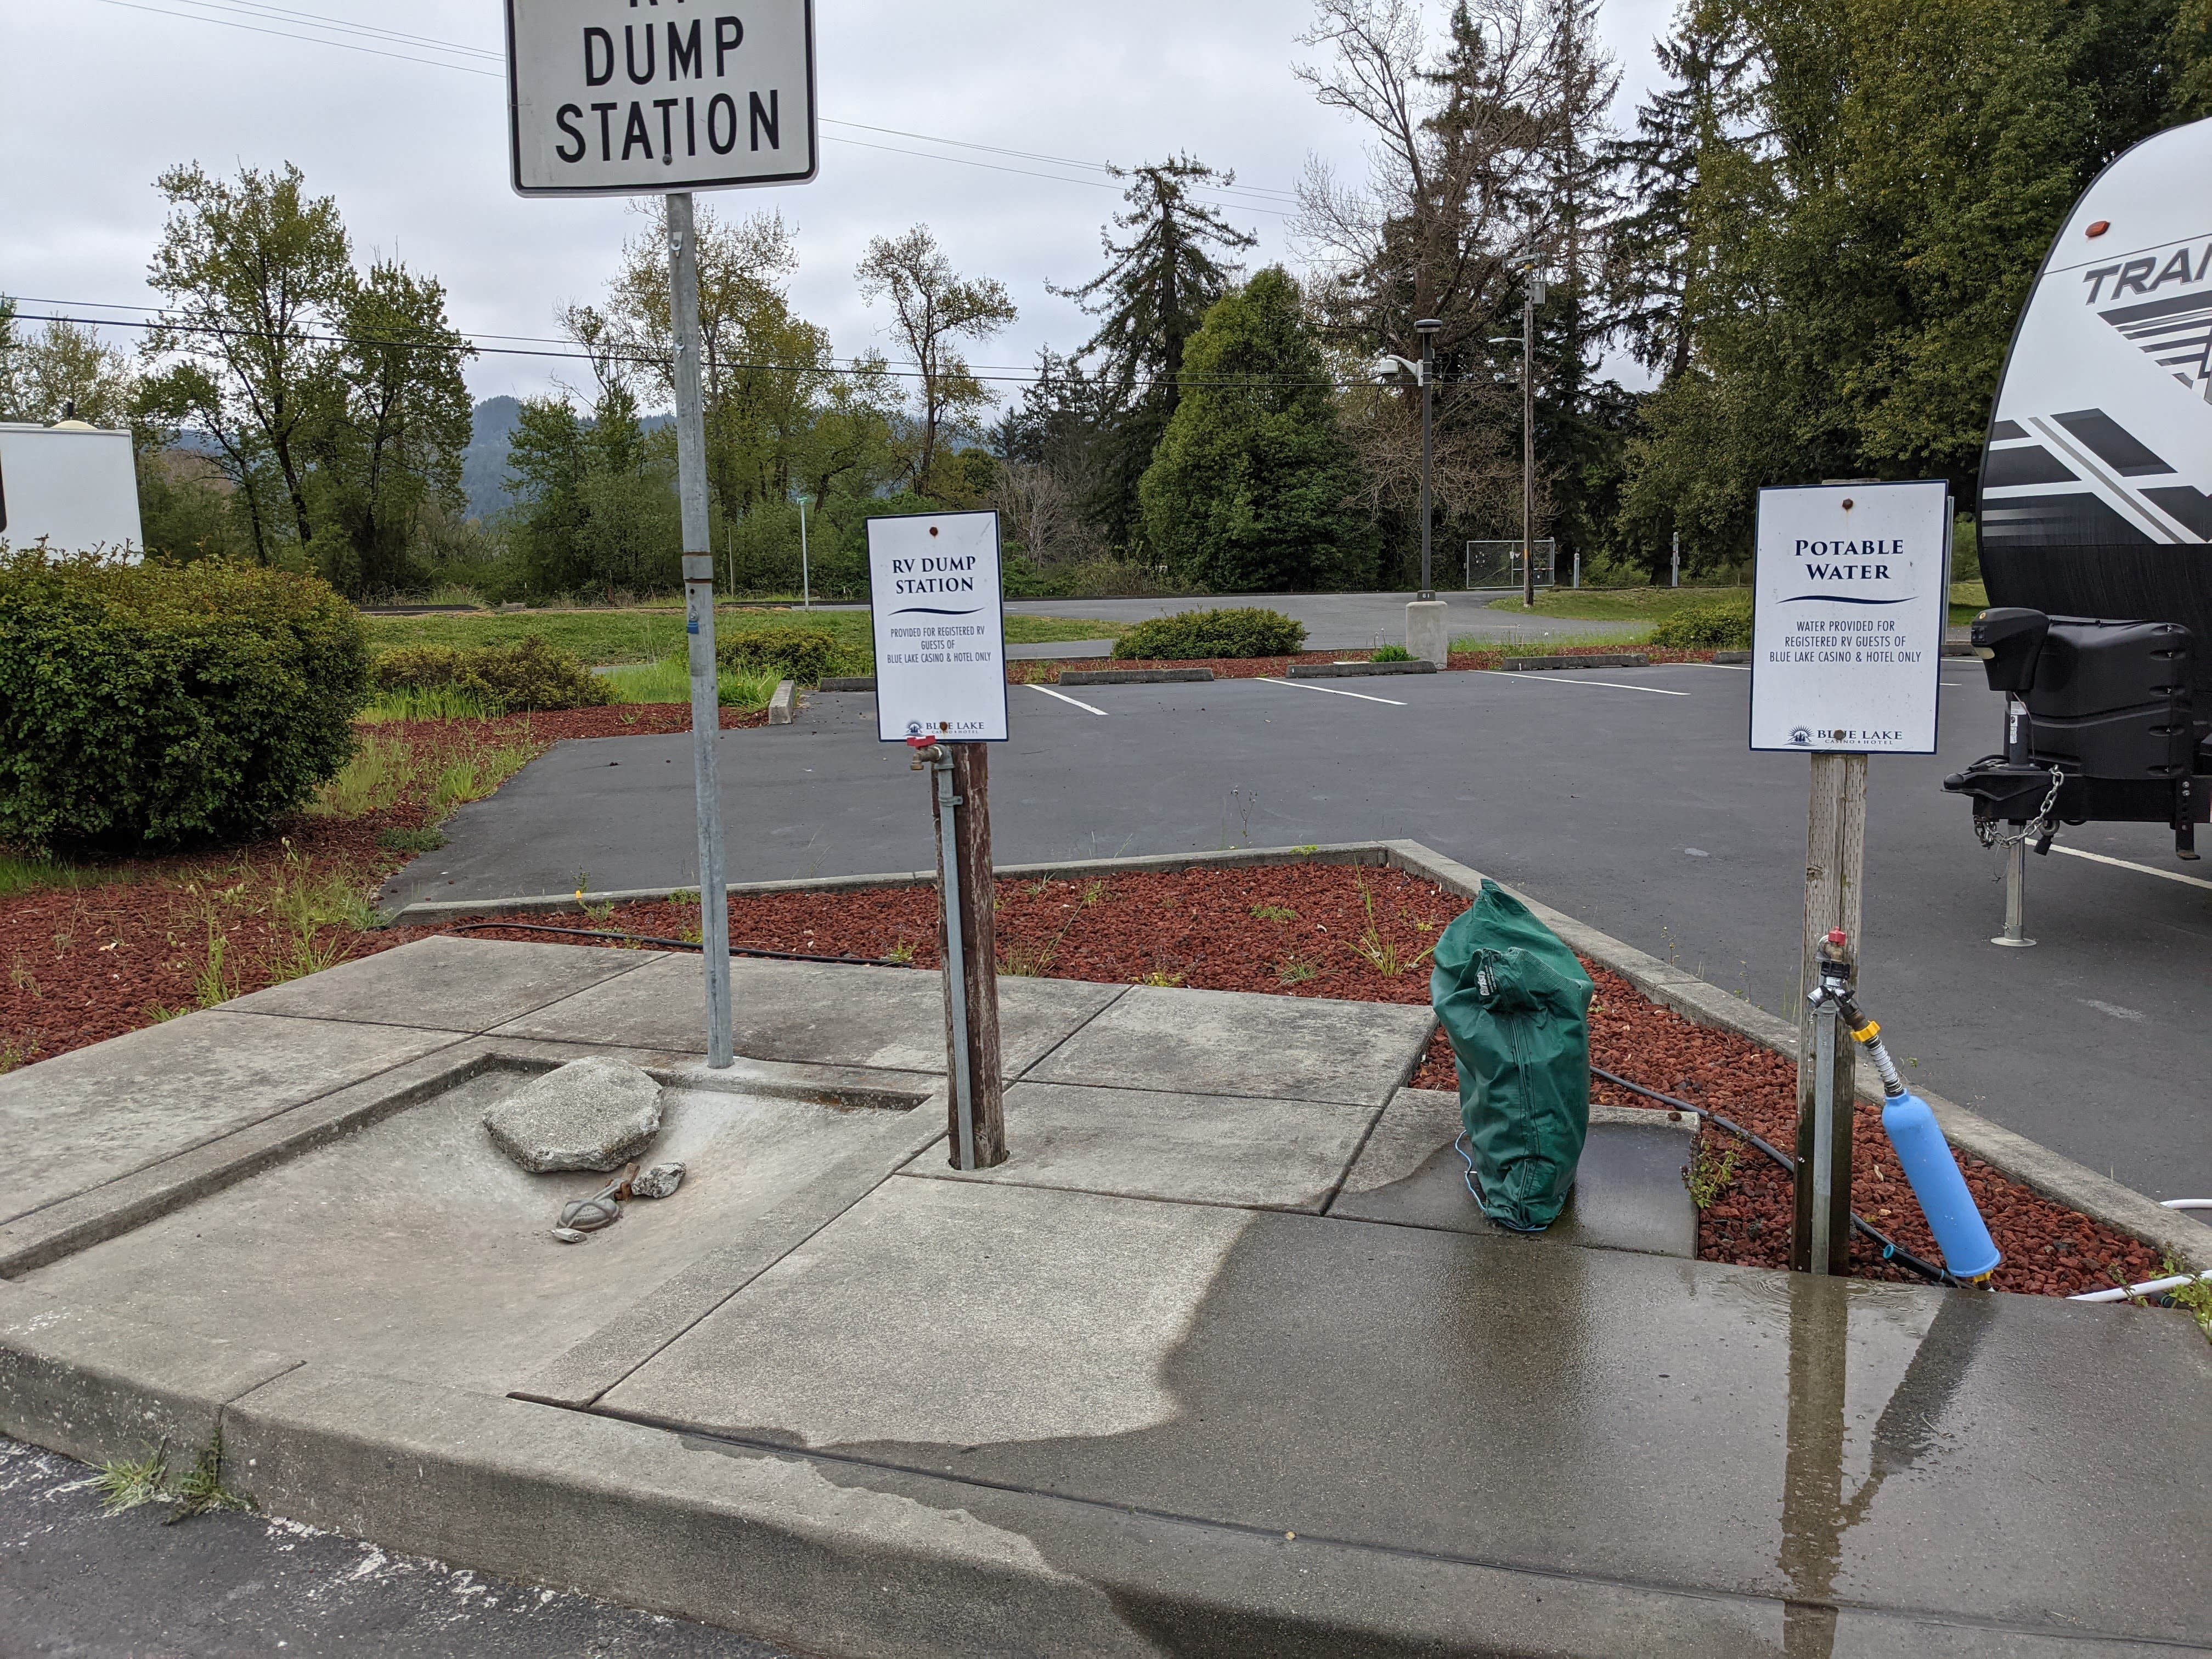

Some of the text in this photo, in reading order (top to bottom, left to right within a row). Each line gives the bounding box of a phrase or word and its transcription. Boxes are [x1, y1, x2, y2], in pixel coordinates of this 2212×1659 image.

[583, 16, 744, 87] DUMP
[555, 89, 780, 163] STATION
[1795, 539, 1904, 556] POTABLE
[892, 556, 975, 574] RV DUMP
[1804, 564, 1892, 580] WATER
[896, 577, 974, 594] STATION
[890, 625, 985, 638] PROVIDED FOR REGISTERED RV
[1797, 620, 1895, 631] WATER PROVIDED FOR
[921, 640, 955, 650] GUESTS OF
[1785, 636, 1906, 647] REGISTERED RV GUESTS OF
[887, 651, 991, 664] BLUE LAKE CASINO & HOTEL ONLY
[1770, 651, 1921, 662] BLUE LAKE CASINO & HOTEL ONLY
[1863, 731, 1903, 740] LAKE
